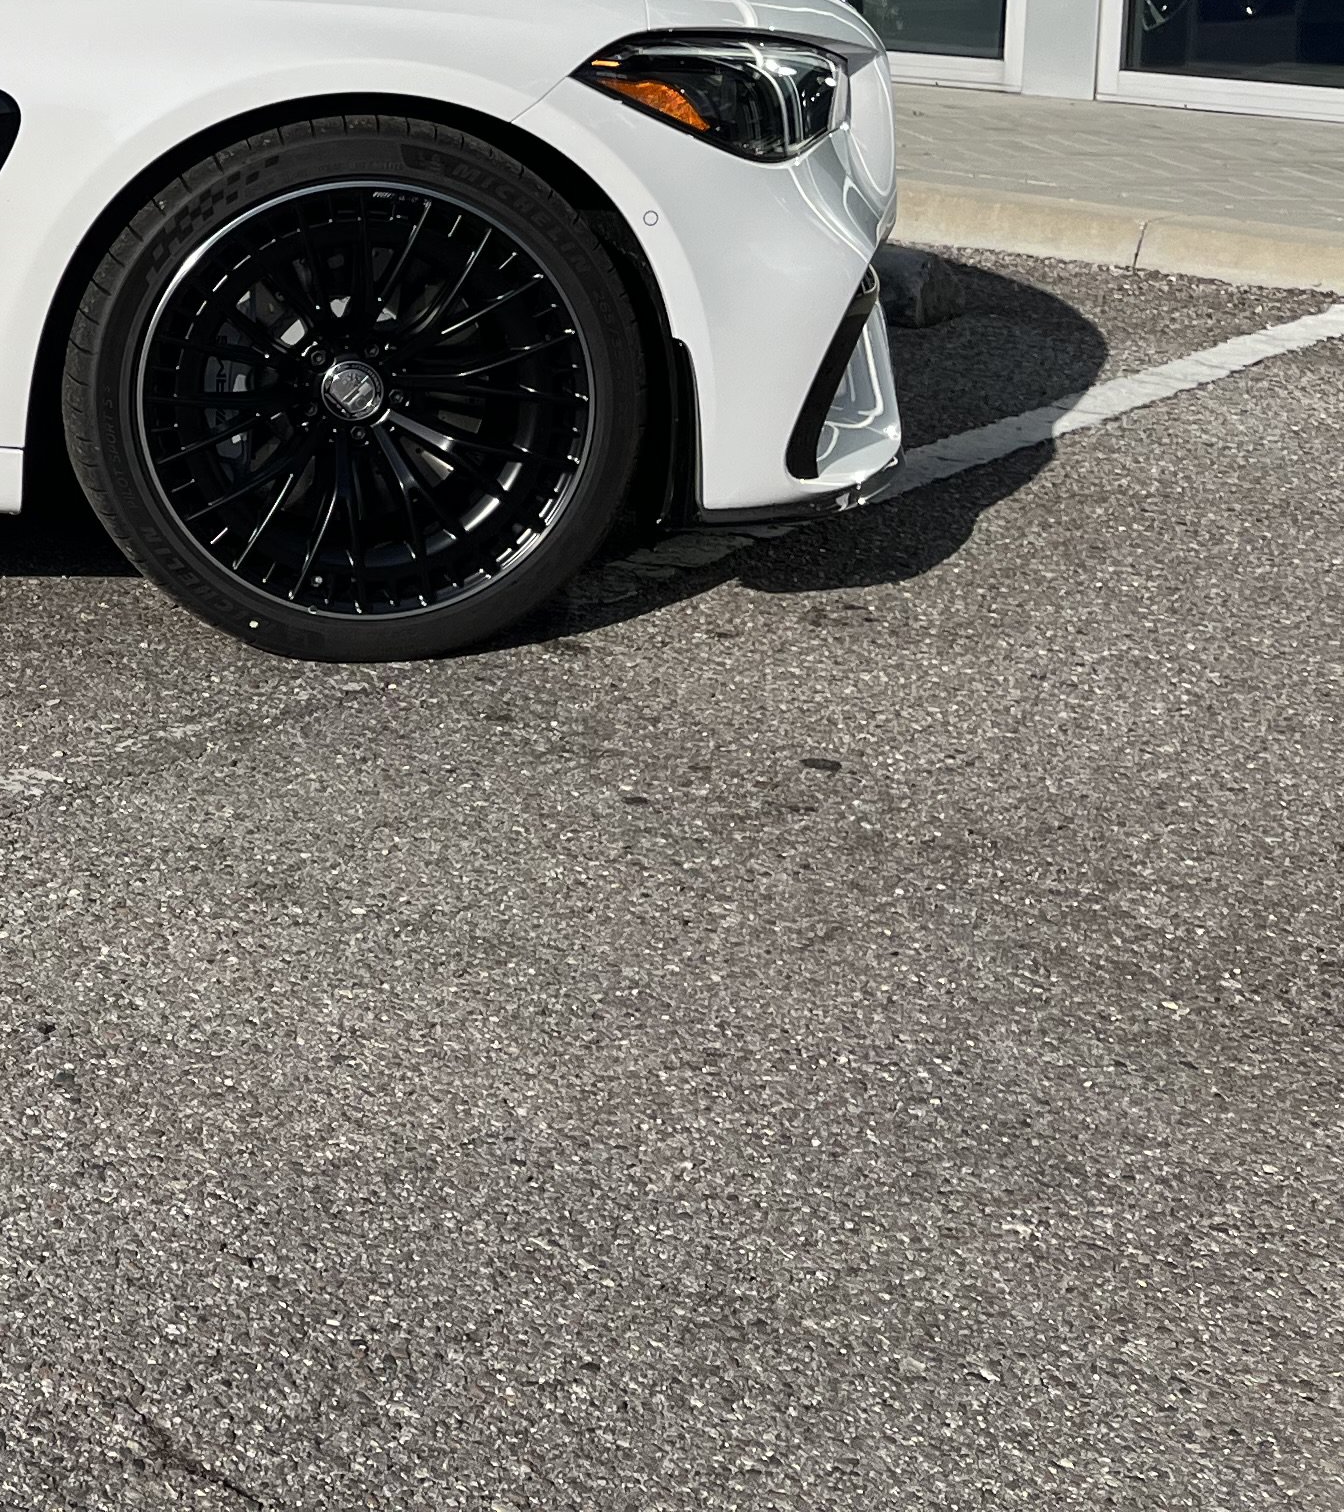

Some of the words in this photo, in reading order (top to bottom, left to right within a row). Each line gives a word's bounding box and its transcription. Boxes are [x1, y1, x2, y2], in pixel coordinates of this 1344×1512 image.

[451, 161, 591, 276] MICHELIN
[102, 414, 122, 467] SPORT
[112, 467, 139, 512] PILOT
